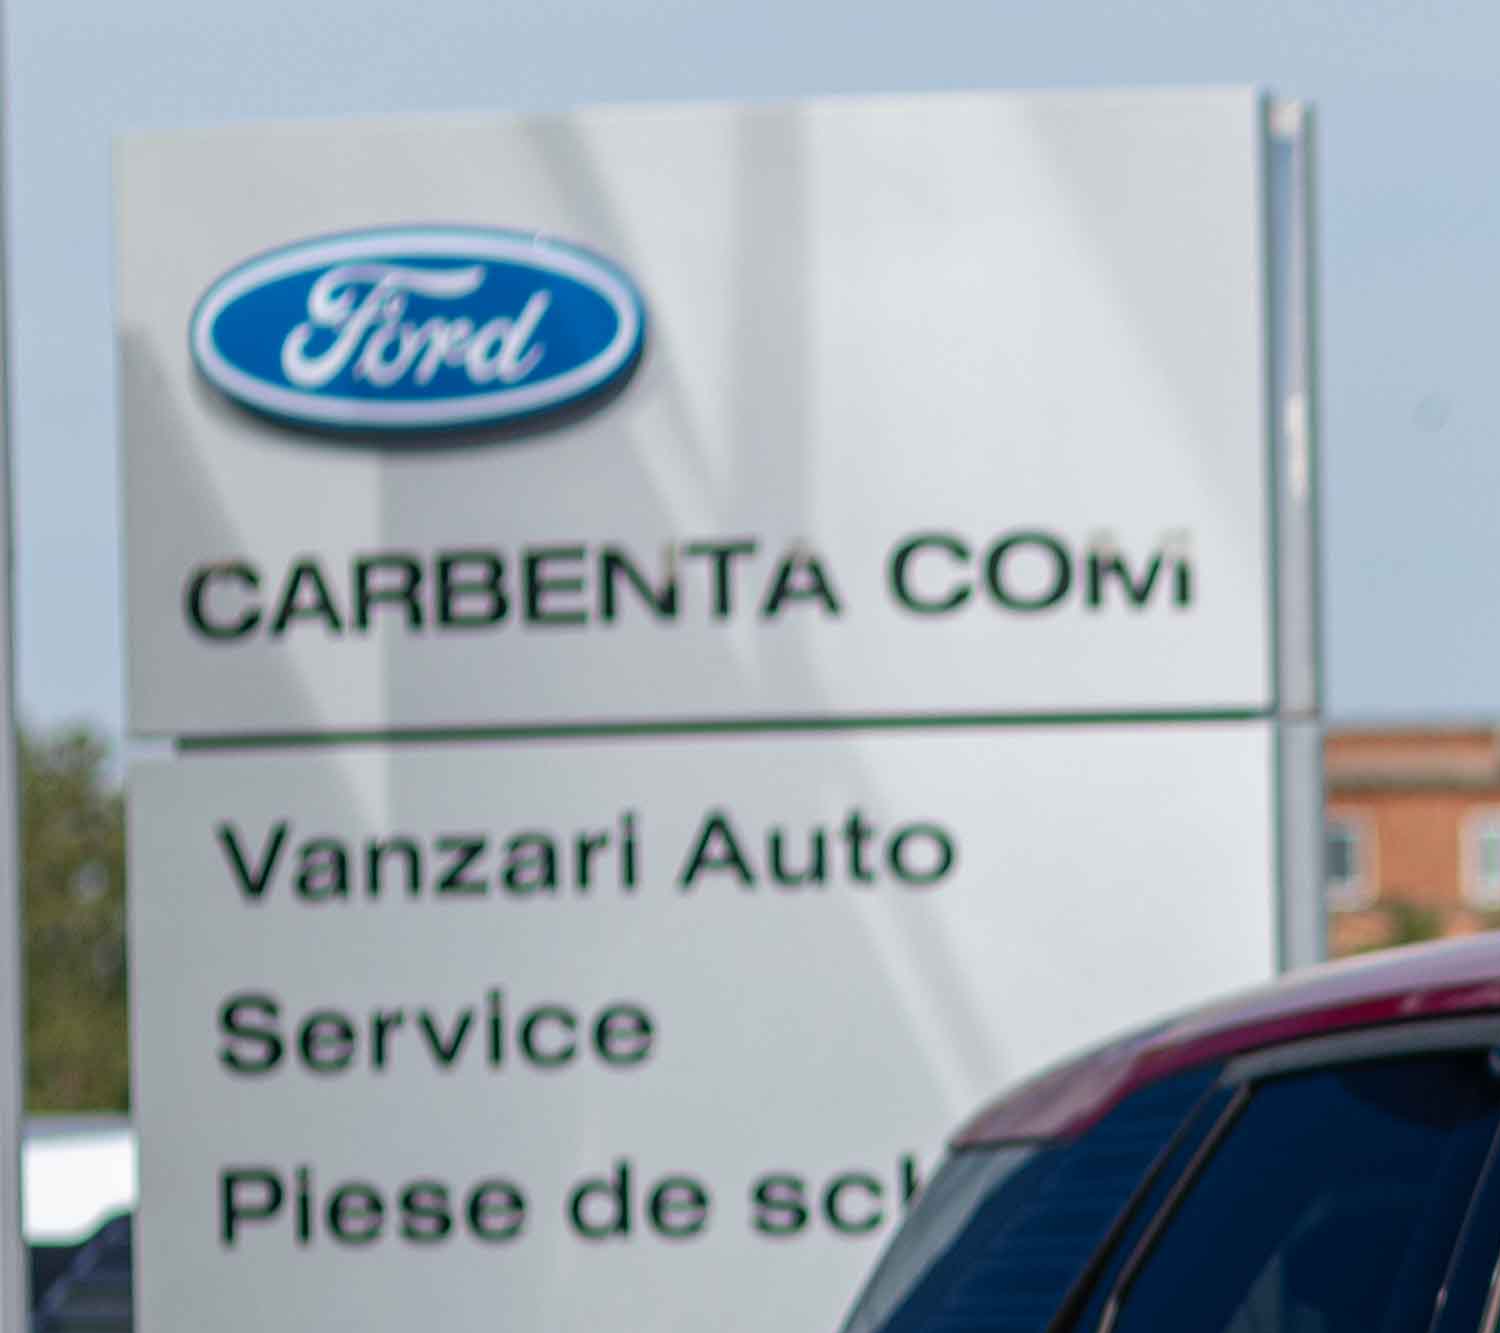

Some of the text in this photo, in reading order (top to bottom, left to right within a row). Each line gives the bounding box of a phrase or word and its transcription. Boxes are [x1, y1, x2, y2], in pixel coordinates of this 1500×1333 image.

[282, 262, 550, 389] Ford
[186, 531, 1192, 640] CARBENTA COM
[214, 808, 957, 903] Vanzari Auto
[216, 986, 657, 1075] Service
[218, 1161, 528, 1246] Piese
[565, 1155, 711, 1240] de
